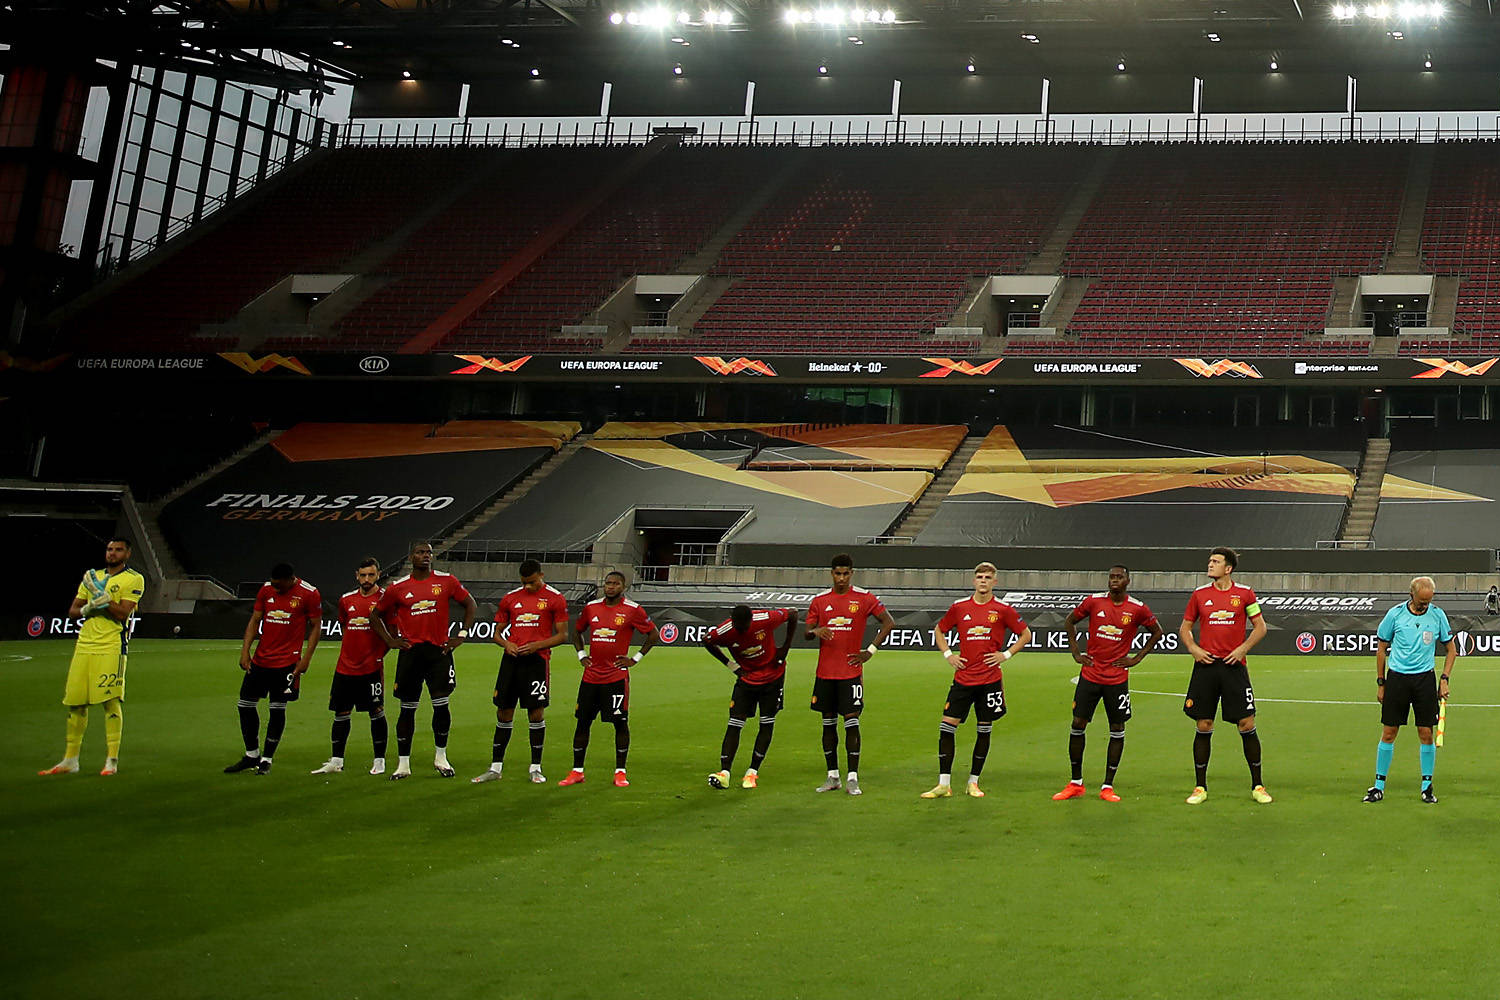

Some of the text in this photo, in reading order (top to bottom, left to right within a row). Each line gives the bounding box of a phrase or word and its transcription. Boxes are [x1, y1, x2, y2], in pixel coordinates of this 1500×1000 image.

[77, 359, 204, 369] UEFA EUROPA LEAGUE
[364, 360, 384, 369] KIA
[560, 361, 658, 370] UEFA EUROPA LEAGUE
[808, 362, 850, 372] Heineken
[1034, 364, 1137, 373] UEFA EUROPA LEAGUE
[205, 493, 455, 510] FINALS 2020
[222, 509, 400, 521] GERMANY
[1323, 634, 1380, 651] RESPE
[448, 665, 455, 678] 6
[97, 673, 117, 688] 22
[286, 673, 294, 687] 9
[370, 682, 382, 696] 18
[530, 680, 548, 696] 26
[851, 684, 863, 700] 10
[1245, 687, 1254, 703] 5
[612, 694, 625, 709] 17
[987, 691, 1003, 708] 53
